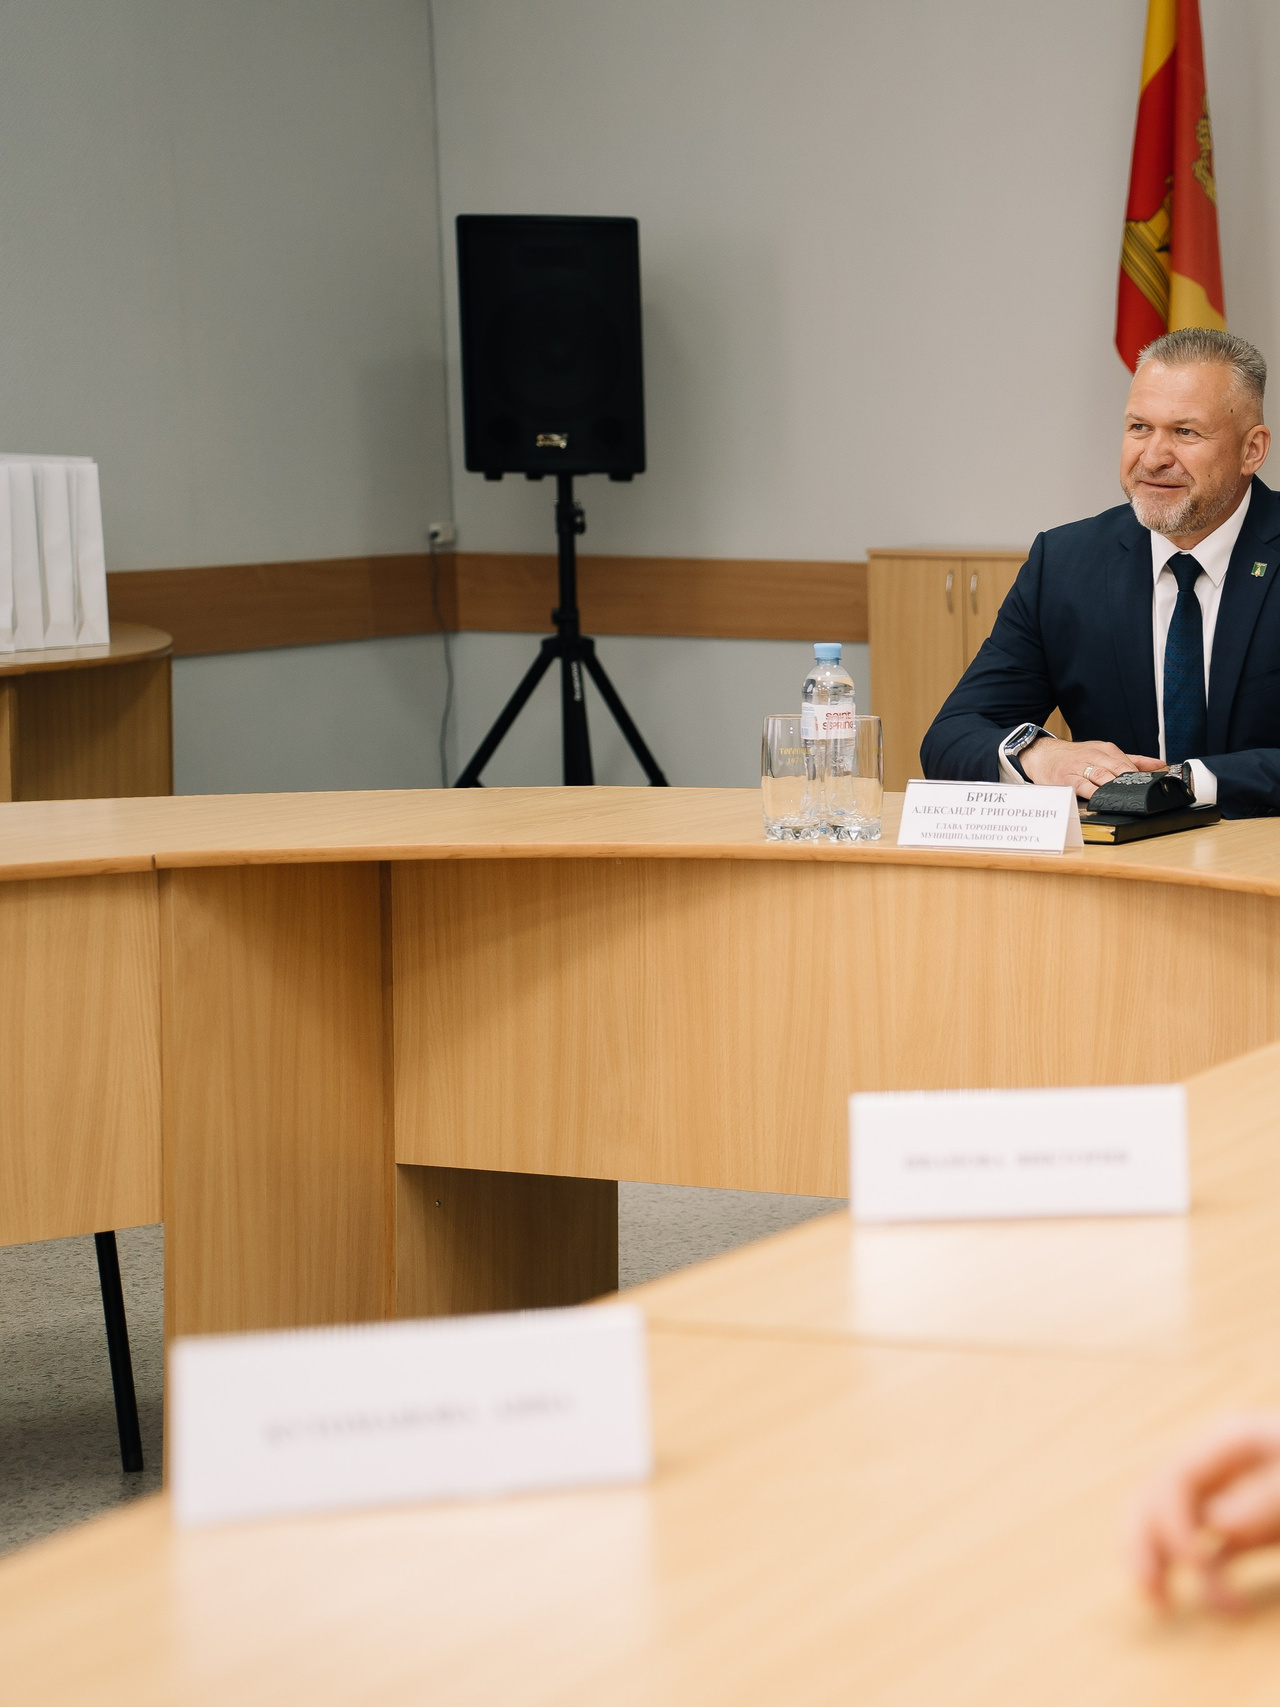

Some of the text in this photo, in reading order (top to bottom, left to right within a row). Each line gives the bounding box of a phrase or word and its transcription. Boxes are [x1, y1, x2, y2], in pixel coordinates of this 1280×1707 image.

[966, 791, 1008, 803] БРИЖ
[911, 805, 1057, 819] АЛЕКСАНДР ГРИГОРЬЕВИЧ
[935, 822, 1028, 832] ГЛАВА ТОРОПЕЦКОГО
[920, 832, 1040, 843] МУНИЦИПАЛЬНОГО ОКРУГА
